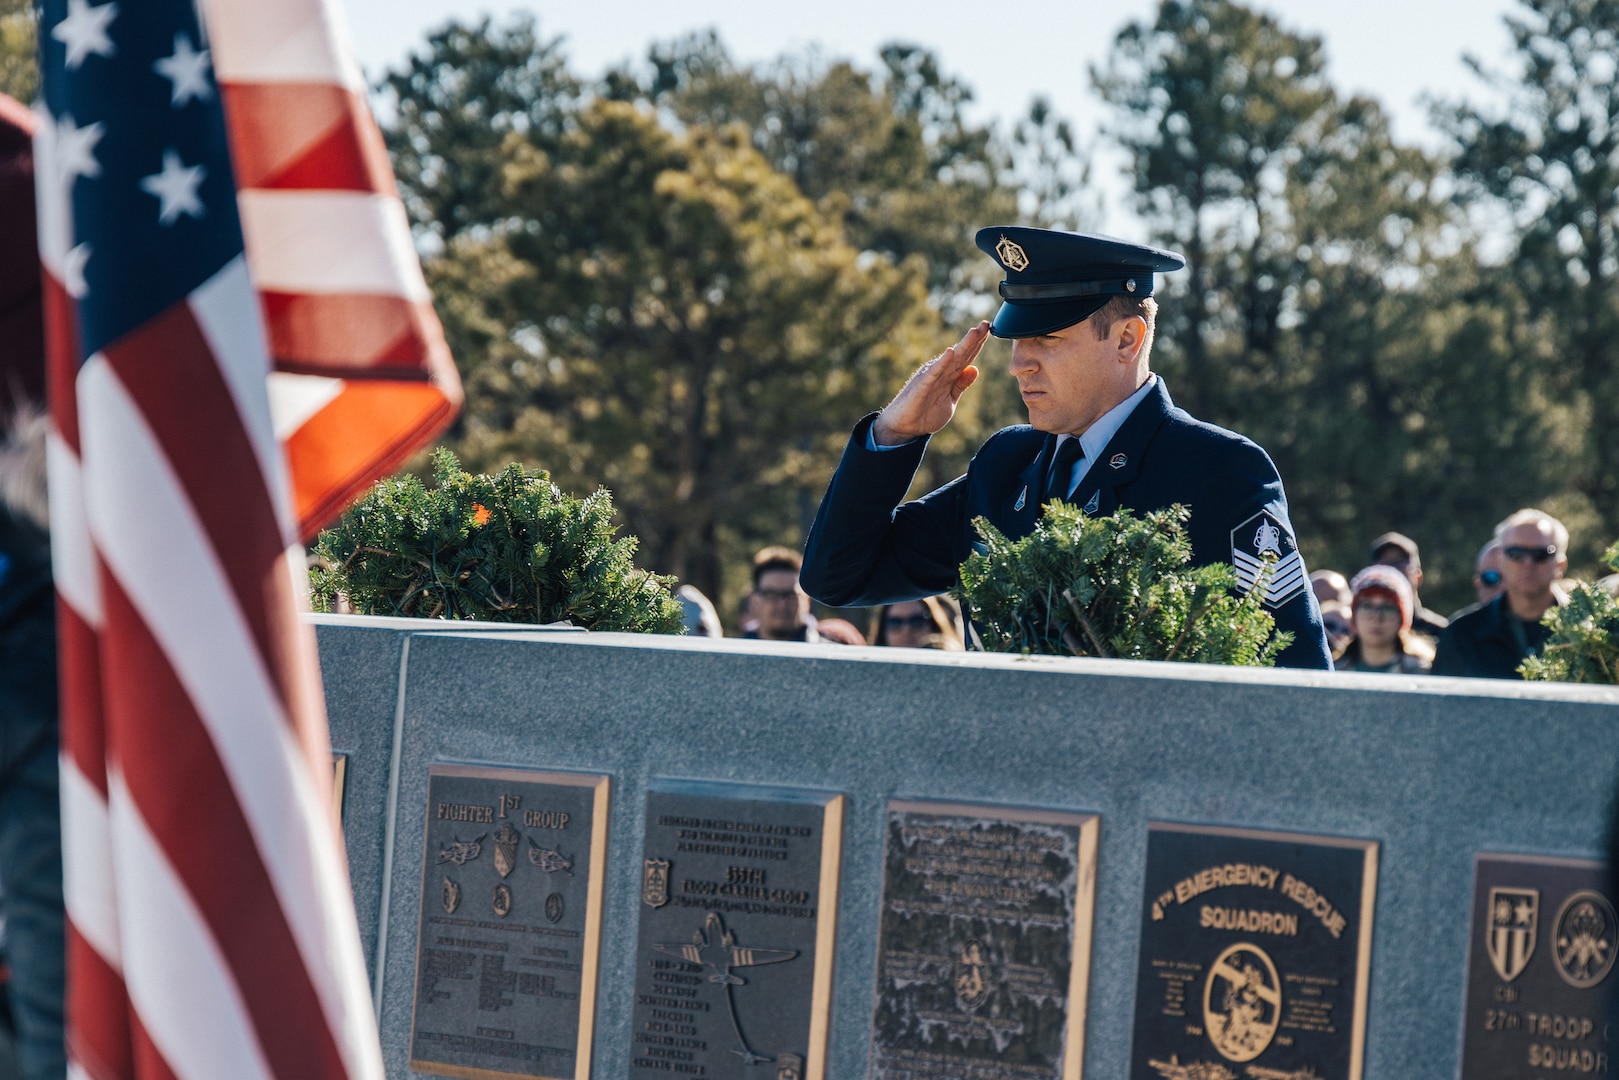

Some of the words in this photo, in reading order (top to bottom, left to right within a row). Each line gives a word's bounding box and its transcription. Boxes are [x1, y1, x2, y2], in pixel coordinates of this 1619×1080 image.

[437, 803, 494, 824] FIGHTER
[498, 795, 521, 819] 1ST
[523, 810, 570, 830] GROUP
[1175, 863, 1280, 904] EMERGENCY
[1281, 873, 1347, 939] RESCUE
[1200, 906, 1298, 936] SQUADRON
[1528, 1013, 1593, 1040] TROOP
